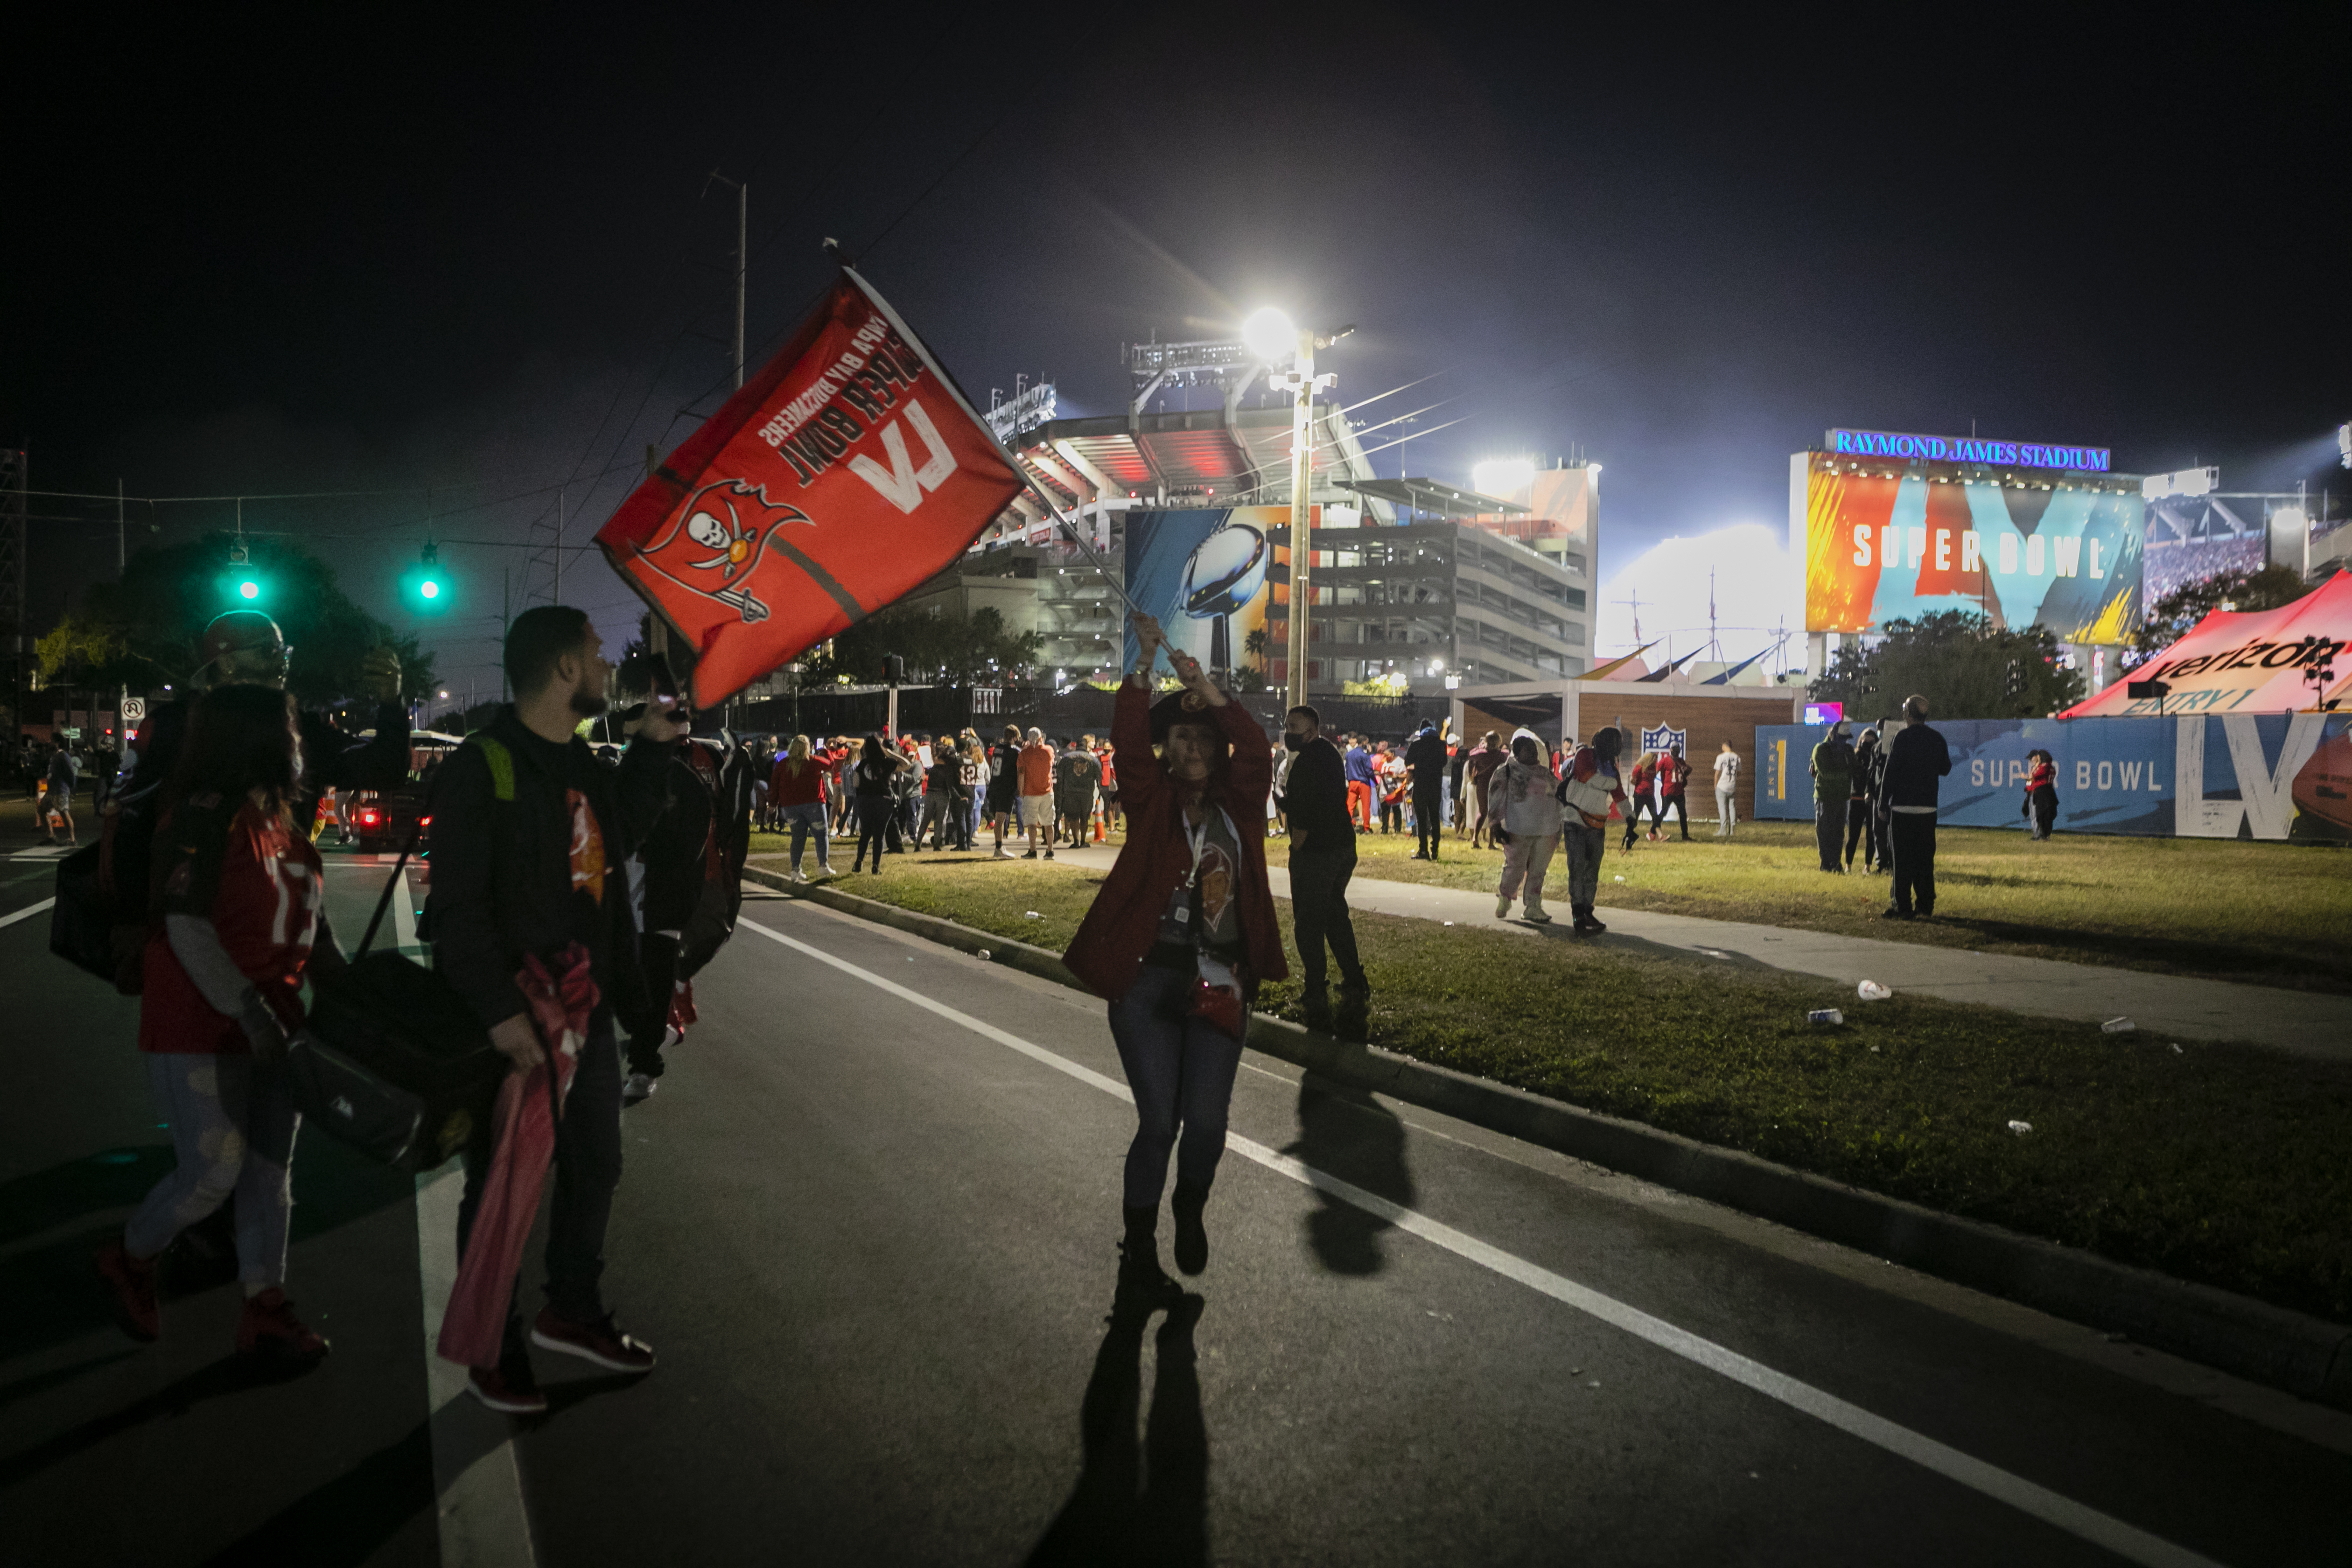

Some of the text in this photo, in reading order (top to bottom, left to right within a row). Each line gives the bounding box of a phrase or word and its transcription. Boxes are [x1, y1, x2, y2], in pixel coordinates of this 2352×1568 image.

[1836, 431, 2108, 472] RAYMOND JAMES STADIUM
[1854, 525, 2104, 579] SUPER BOWL
[2149, 637, 2346, 681] verizon
[959, 765, 976, 785] 12
[1777, 740, 1786, 800] 1
[2076, 761, 2162, 792] BOWL
[2175, 713, 2328, 840] LV
